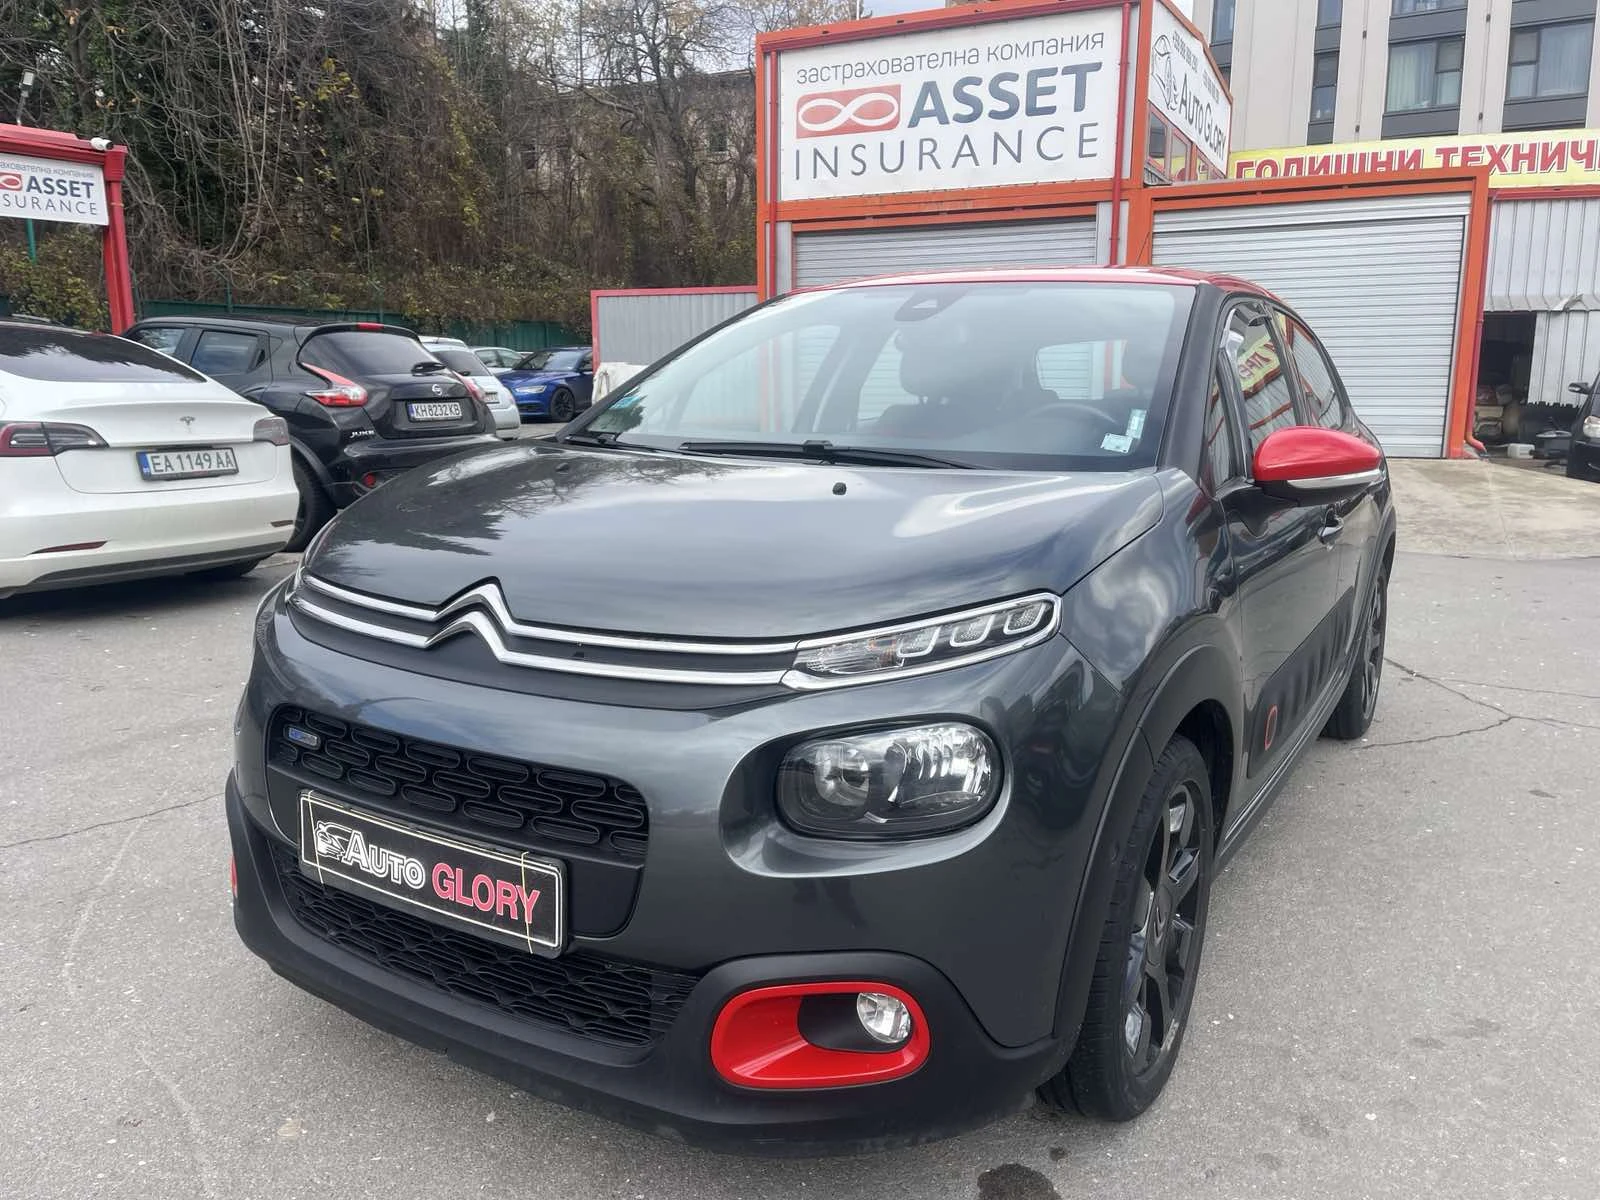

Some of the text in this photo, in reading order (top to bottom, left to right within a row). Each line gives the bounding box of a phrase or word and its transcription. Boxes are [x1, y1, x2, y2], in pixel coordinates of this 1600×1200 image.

[796, 31, 1105, 85] застрахователна компания
[907, 61, 1103, 129] ASSET
[795, 122, 1099, 181] INSURANCE
[1435, 139, 1600, 173] ТЕХНИЧ
[26, 175, 94, 199] ASSET
[431, 862, 541, 924] GLORY
